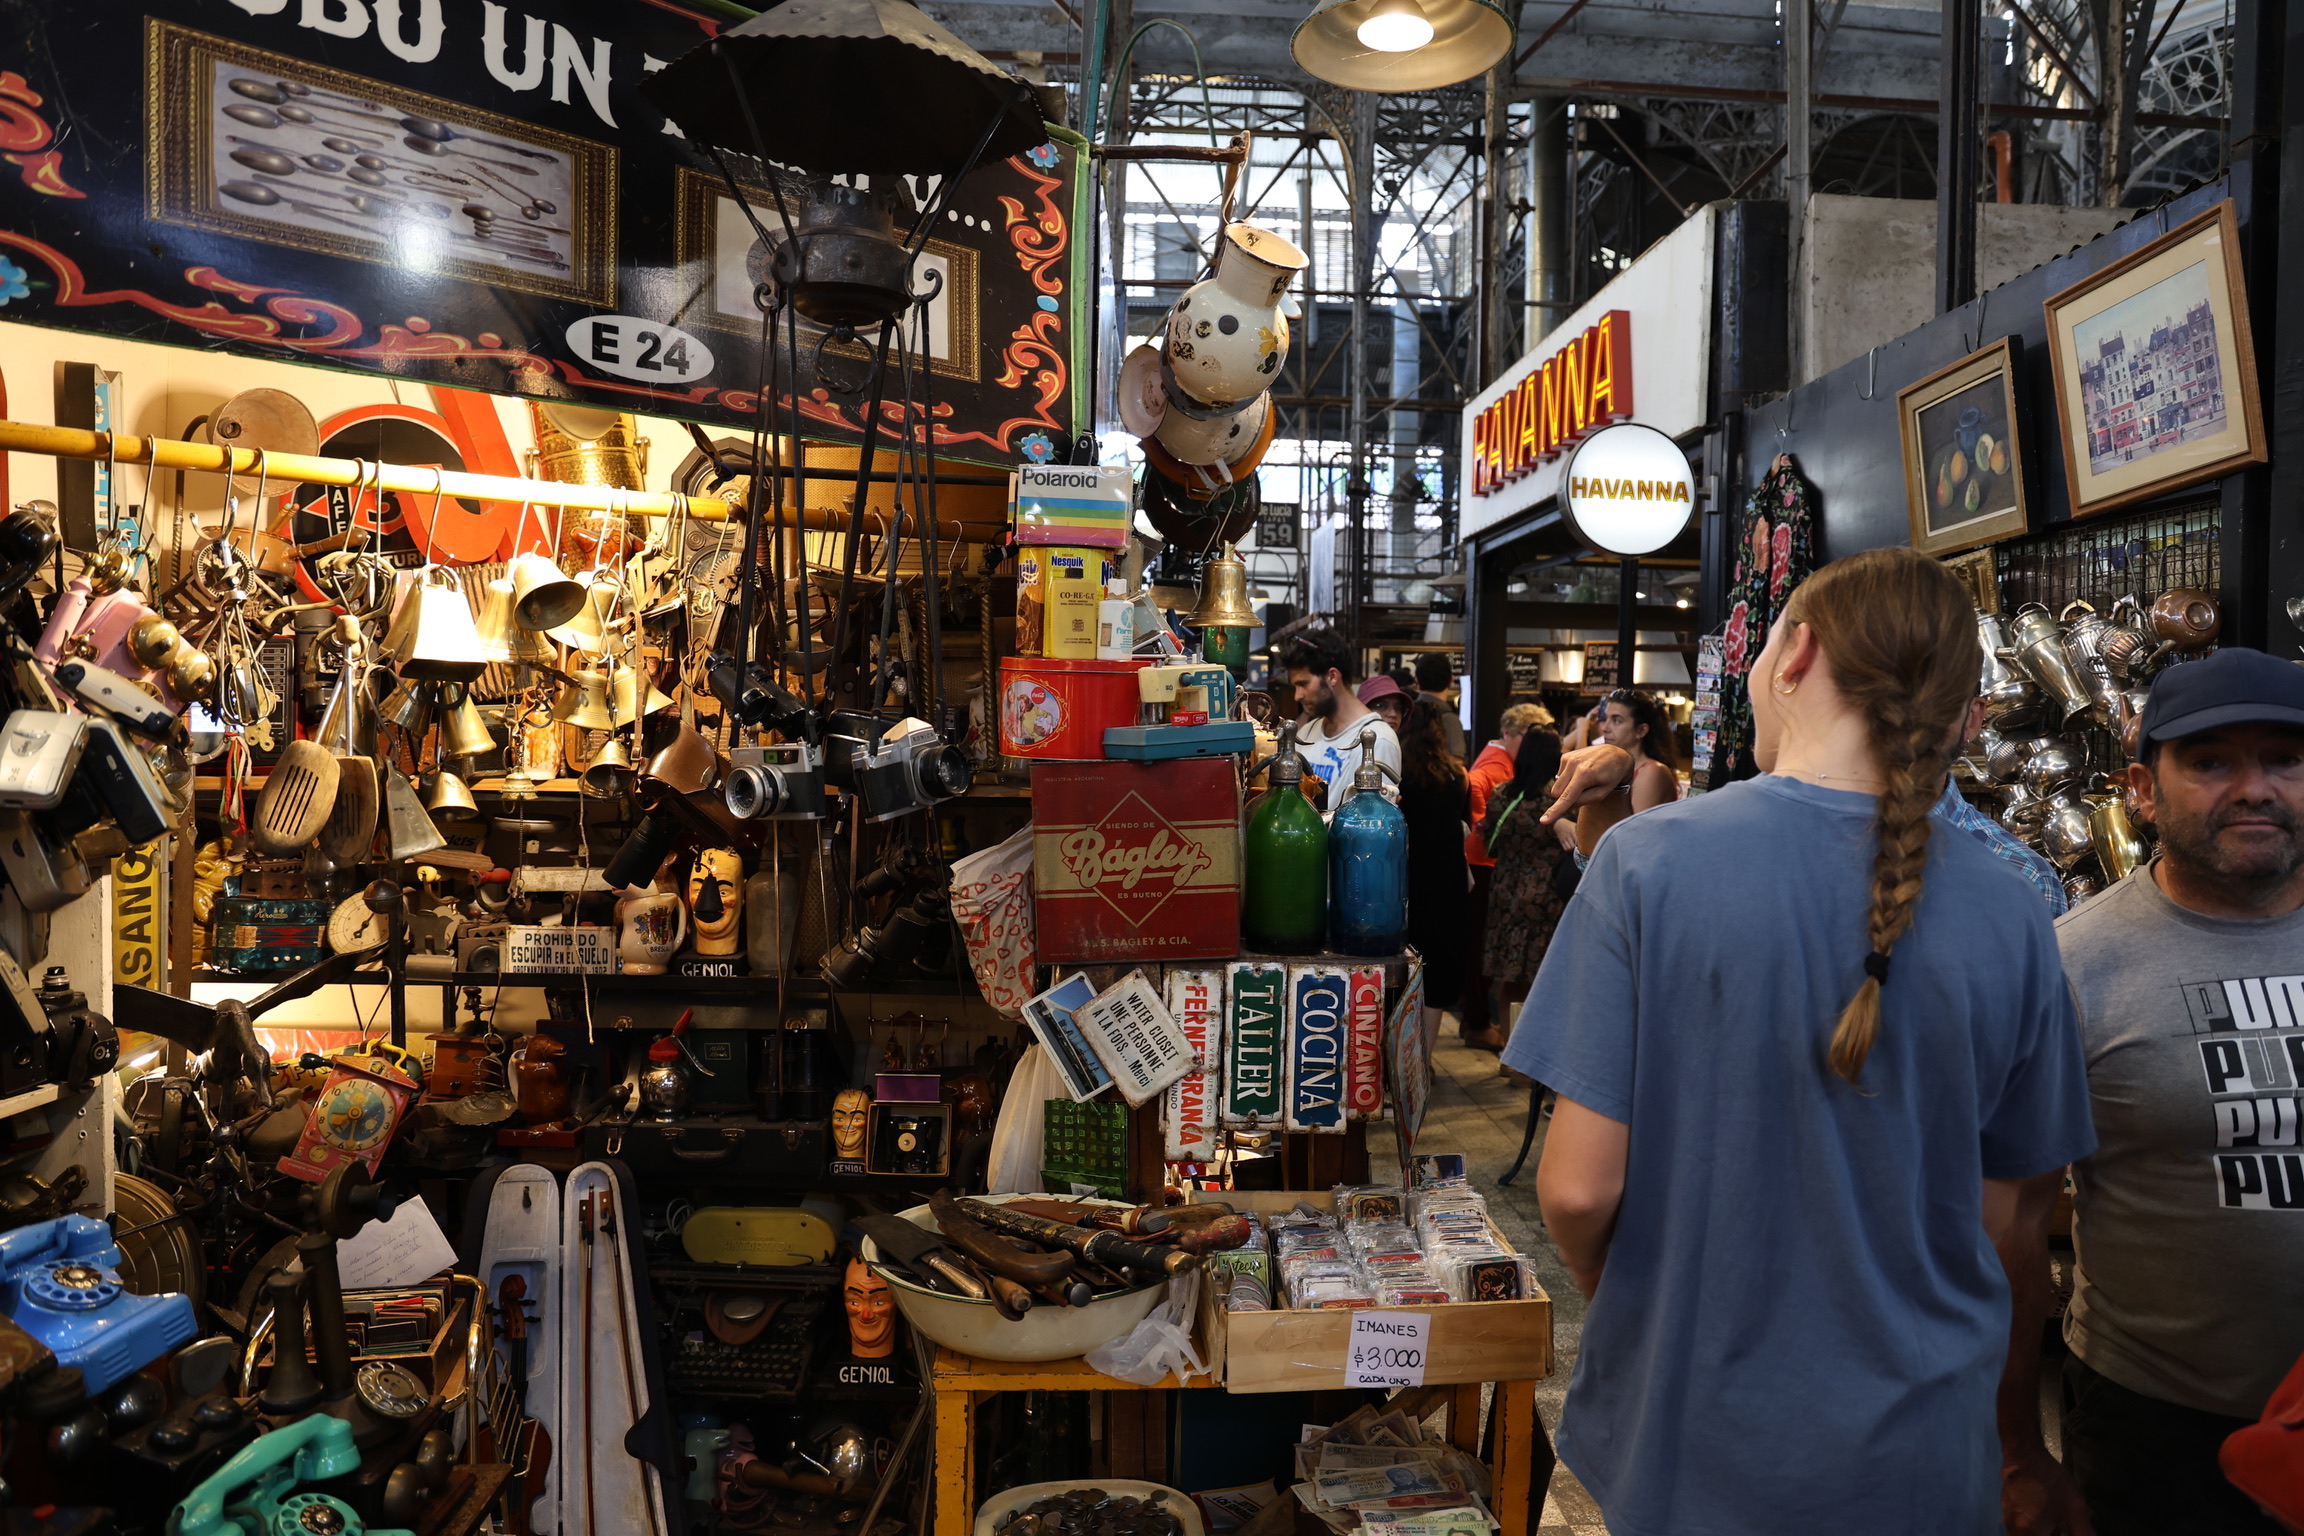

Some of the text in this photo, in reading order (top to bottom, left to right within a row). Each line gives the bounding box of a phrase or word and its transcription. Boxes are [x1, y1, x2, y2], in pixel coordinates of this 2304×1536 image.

[481, 0, 619, 129] UN
[592, 322, 690, 376] E 24
[1472, 311, 1628, 497] HAVANNA
[1022, 468, 1098, 488] Polaroid
[1571, 476, 1690, 502] HAVANNA
[1263, 523, 1292, 545] 59
[1051, 555, 1084, 568] Nesquik
[1106, 822, 1139, 830] SIENDO
[1061, 827, 1211, 889] Bágley
[1132, 891, 1163, 899] BUENO
[525, 933, 597, 946] PROHIBDO
[1113, 937, 1155, 946] BAGLEY
[1158, 936, 1167, 945] &
[1169, 936, 1191, 945] CIA.
[511, 946, 609, 965] ESCUPIR EN EL SUELO
[681, 962, 738, 977] GENIOL
[1110, 1000, 1165, 1074] UNE PERSONNE
[1127, 991, 1180, 1061] WATER CLOSET
[1183, 985, 1208, 1066] FERNE
[1091, 1008, 1101, 1018] A
[1098, 1016, 1110, 1032] LA
[1128, 1060, 1154, 1088] Merci
[1236, 985, 1275, 1101] TALLER
[1300, 988, 1339, 1112] COCINA
[1355, 984, 1381, 1106] CINZANO
[1170, 1080, 1178, 1110] UNDO
[833, 1164, 863, 1173] GENIOL
[1356, 1320, 1418, 1338] IMANES
[839, 1366, 895, 1384] GENIOL
[1359, 1375, 1411, 1387] CADA UNO
